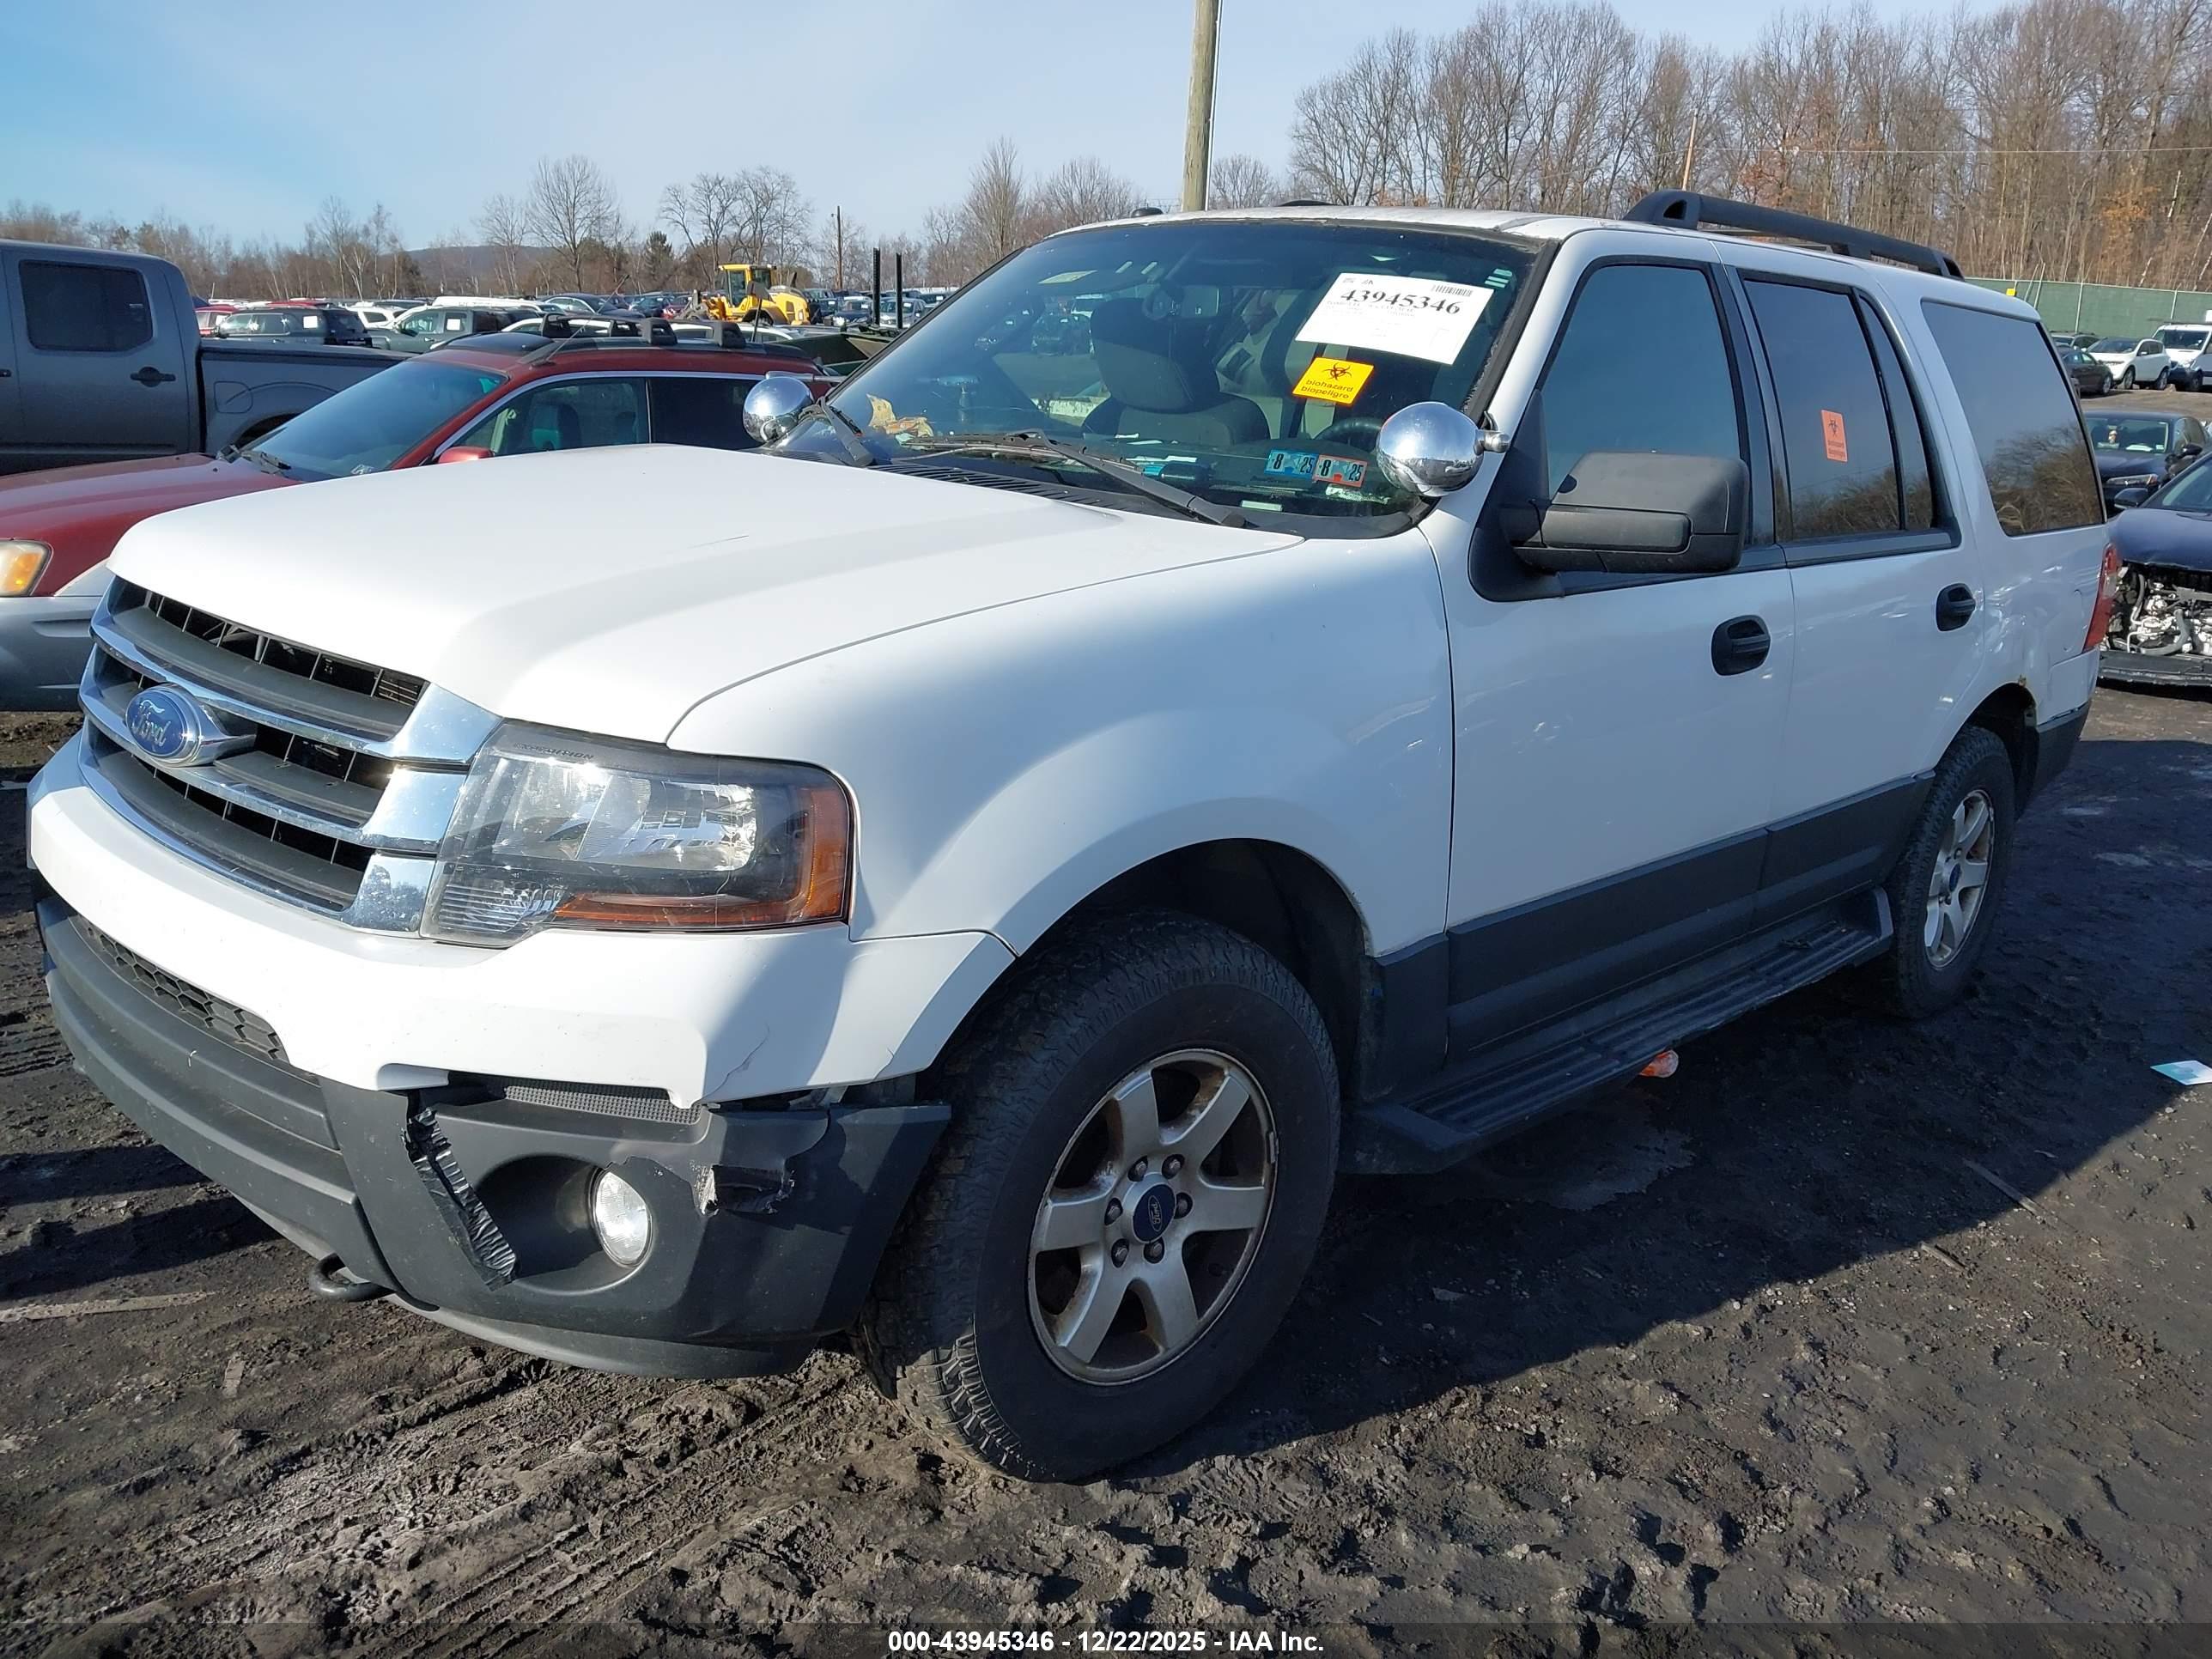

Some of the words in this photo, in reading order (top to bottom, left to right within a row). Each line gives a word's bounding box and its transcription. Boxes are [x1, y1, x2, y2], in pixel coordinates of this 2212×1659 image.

[1340, 289, 1463, 314] 43945346
[1300, 386, 1350, 399] biopeligro
[1305, 379, 1354, 392] biohazard
[1273, 453, 1285, 470] 8
[1300, 456, 1316, 474] 25
[1320, 459, 1332, 477] 8
[1348, 464, 1364, 481] 25
[131, 699, 172, 751] Ford
[1151, 1203, 1162, 1224] Ford
